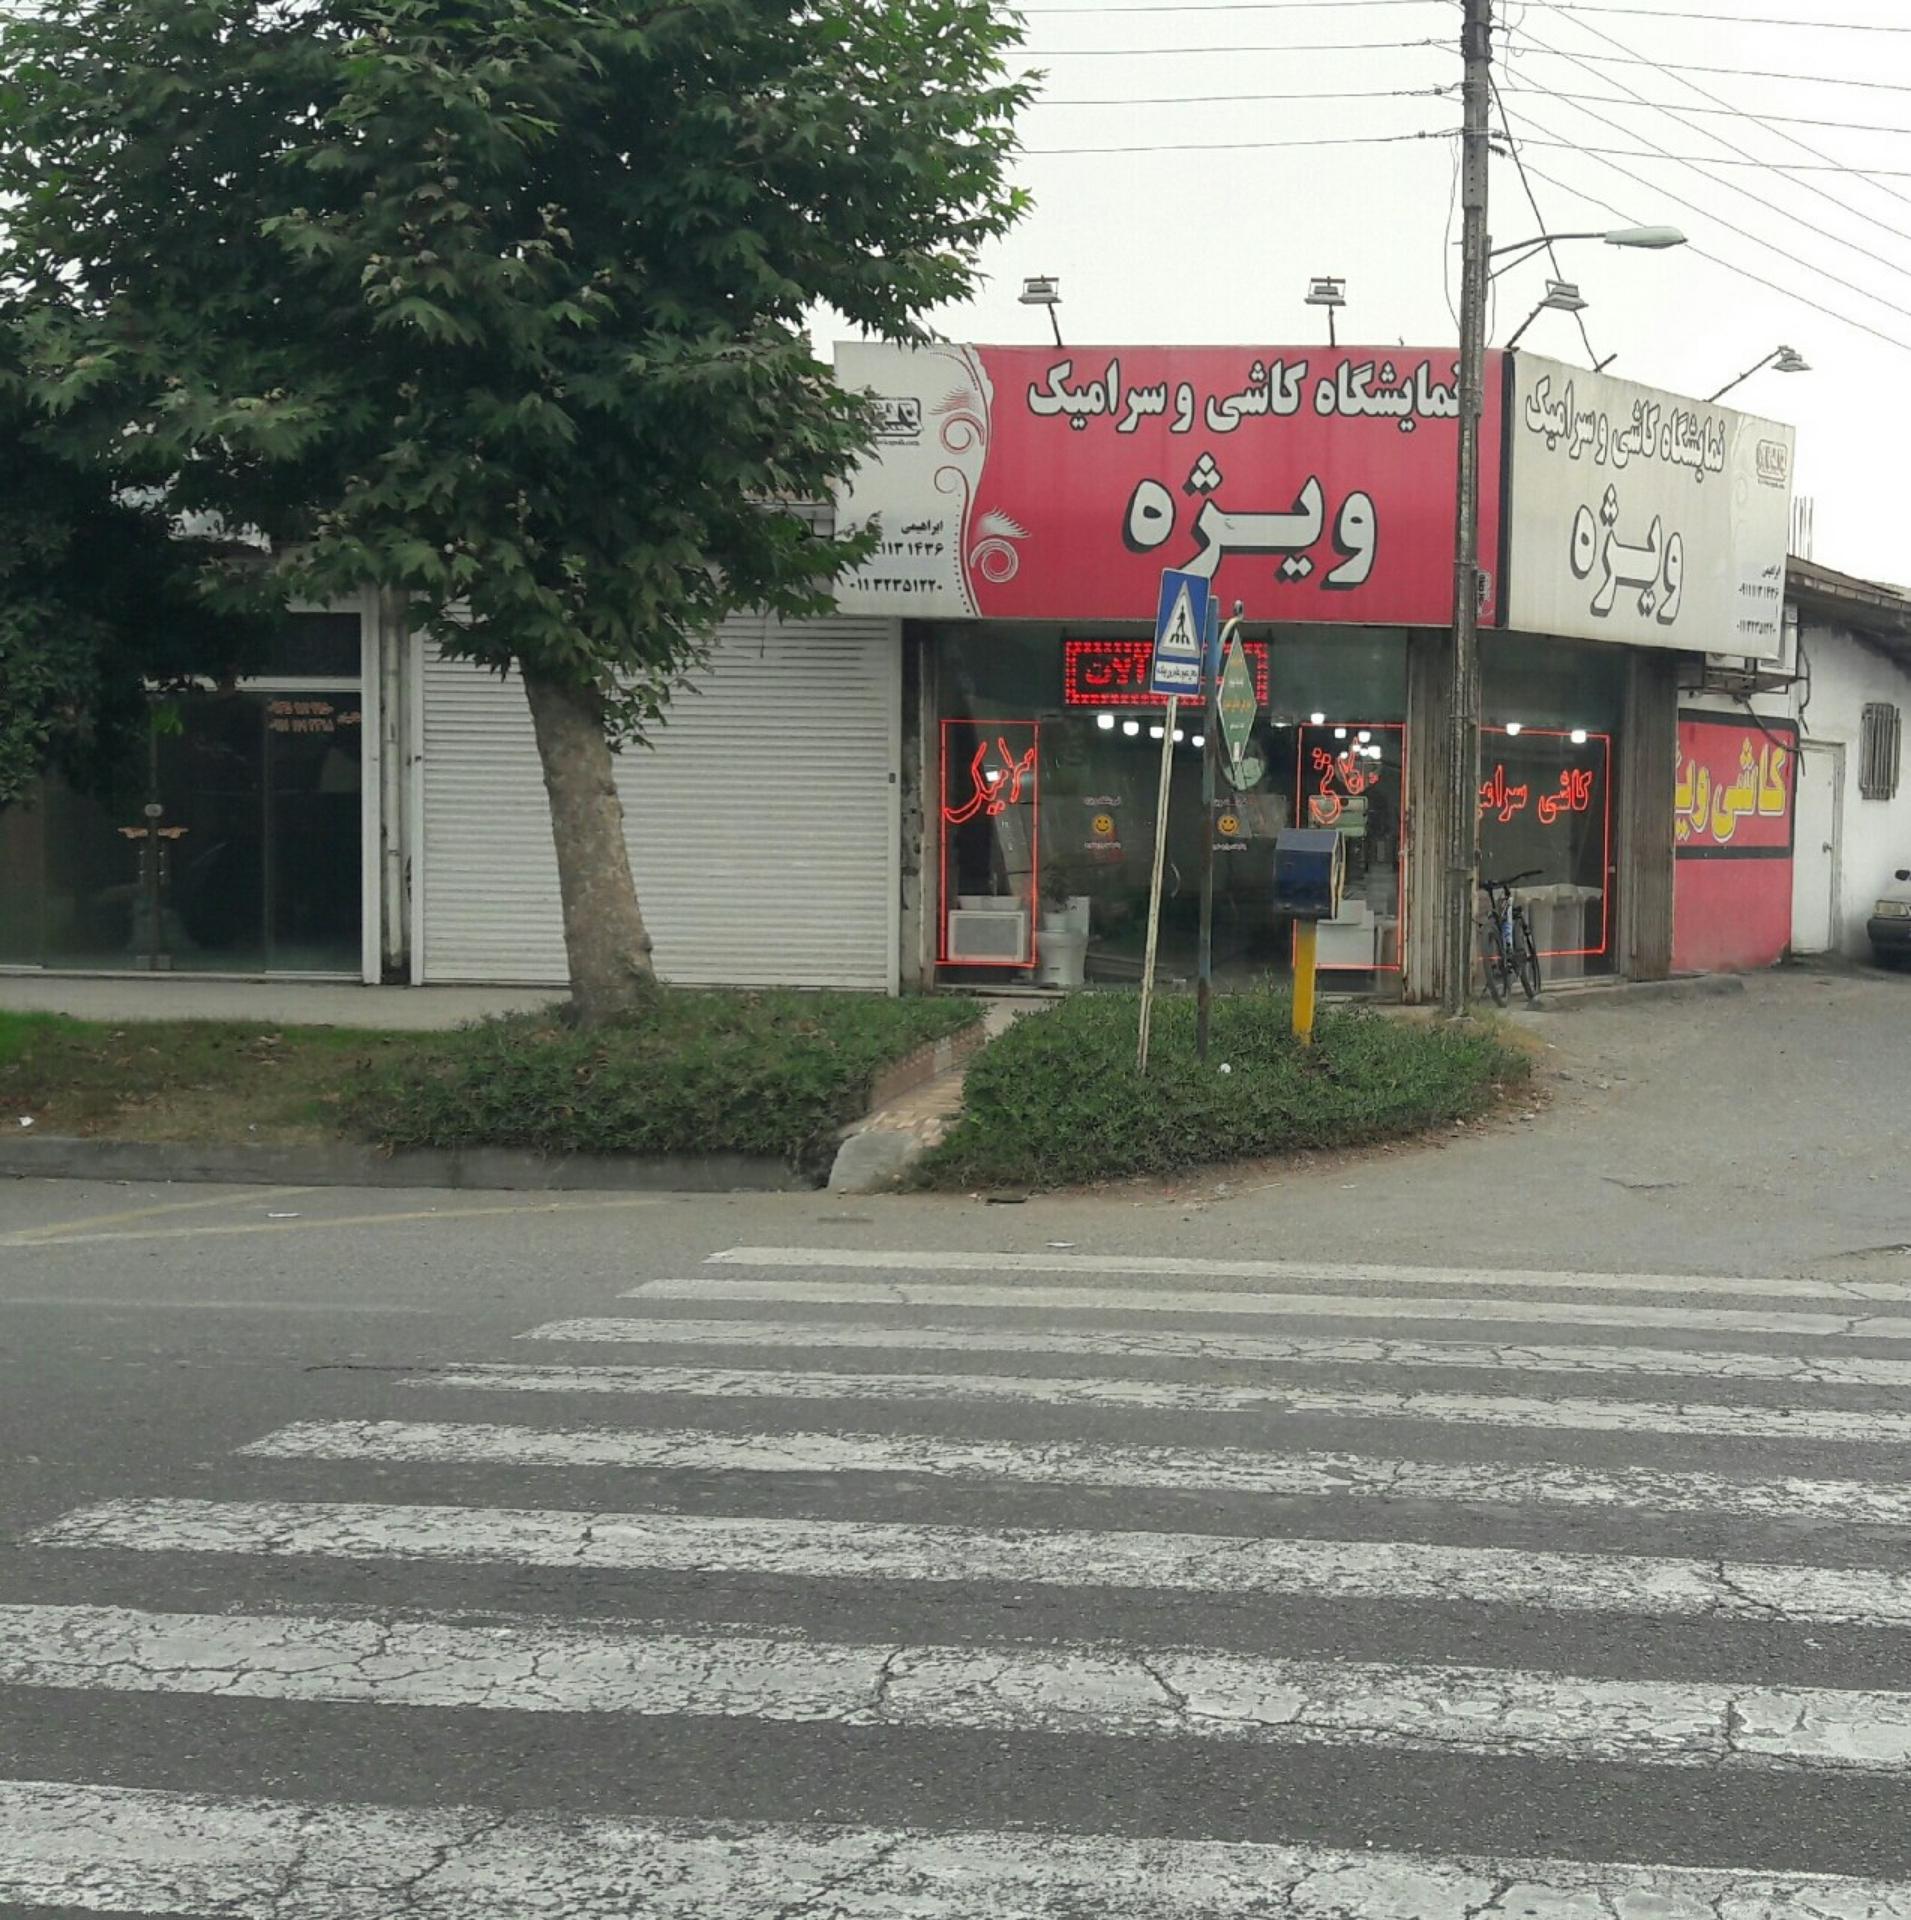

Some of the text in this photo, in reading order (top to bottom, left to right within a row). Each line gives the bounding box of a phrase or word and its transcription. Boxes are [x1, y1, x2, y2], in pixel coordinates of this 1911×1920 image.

[1027, 357, 1168, 433] سرامیک
[1169, 382, 1195, 434] و
[1205, 358, 1309, 433] کاشی
[1525, 374, 1725, 482] نمایشگاه کاشی و سرامیک
[1122, 451, 1377, 591] ویژه
[1570, 483, 1683, 625] ویژه
[1538, 768, 1593, 824] کاشی
[1676, 737, 1786, 843] کاشی وی
